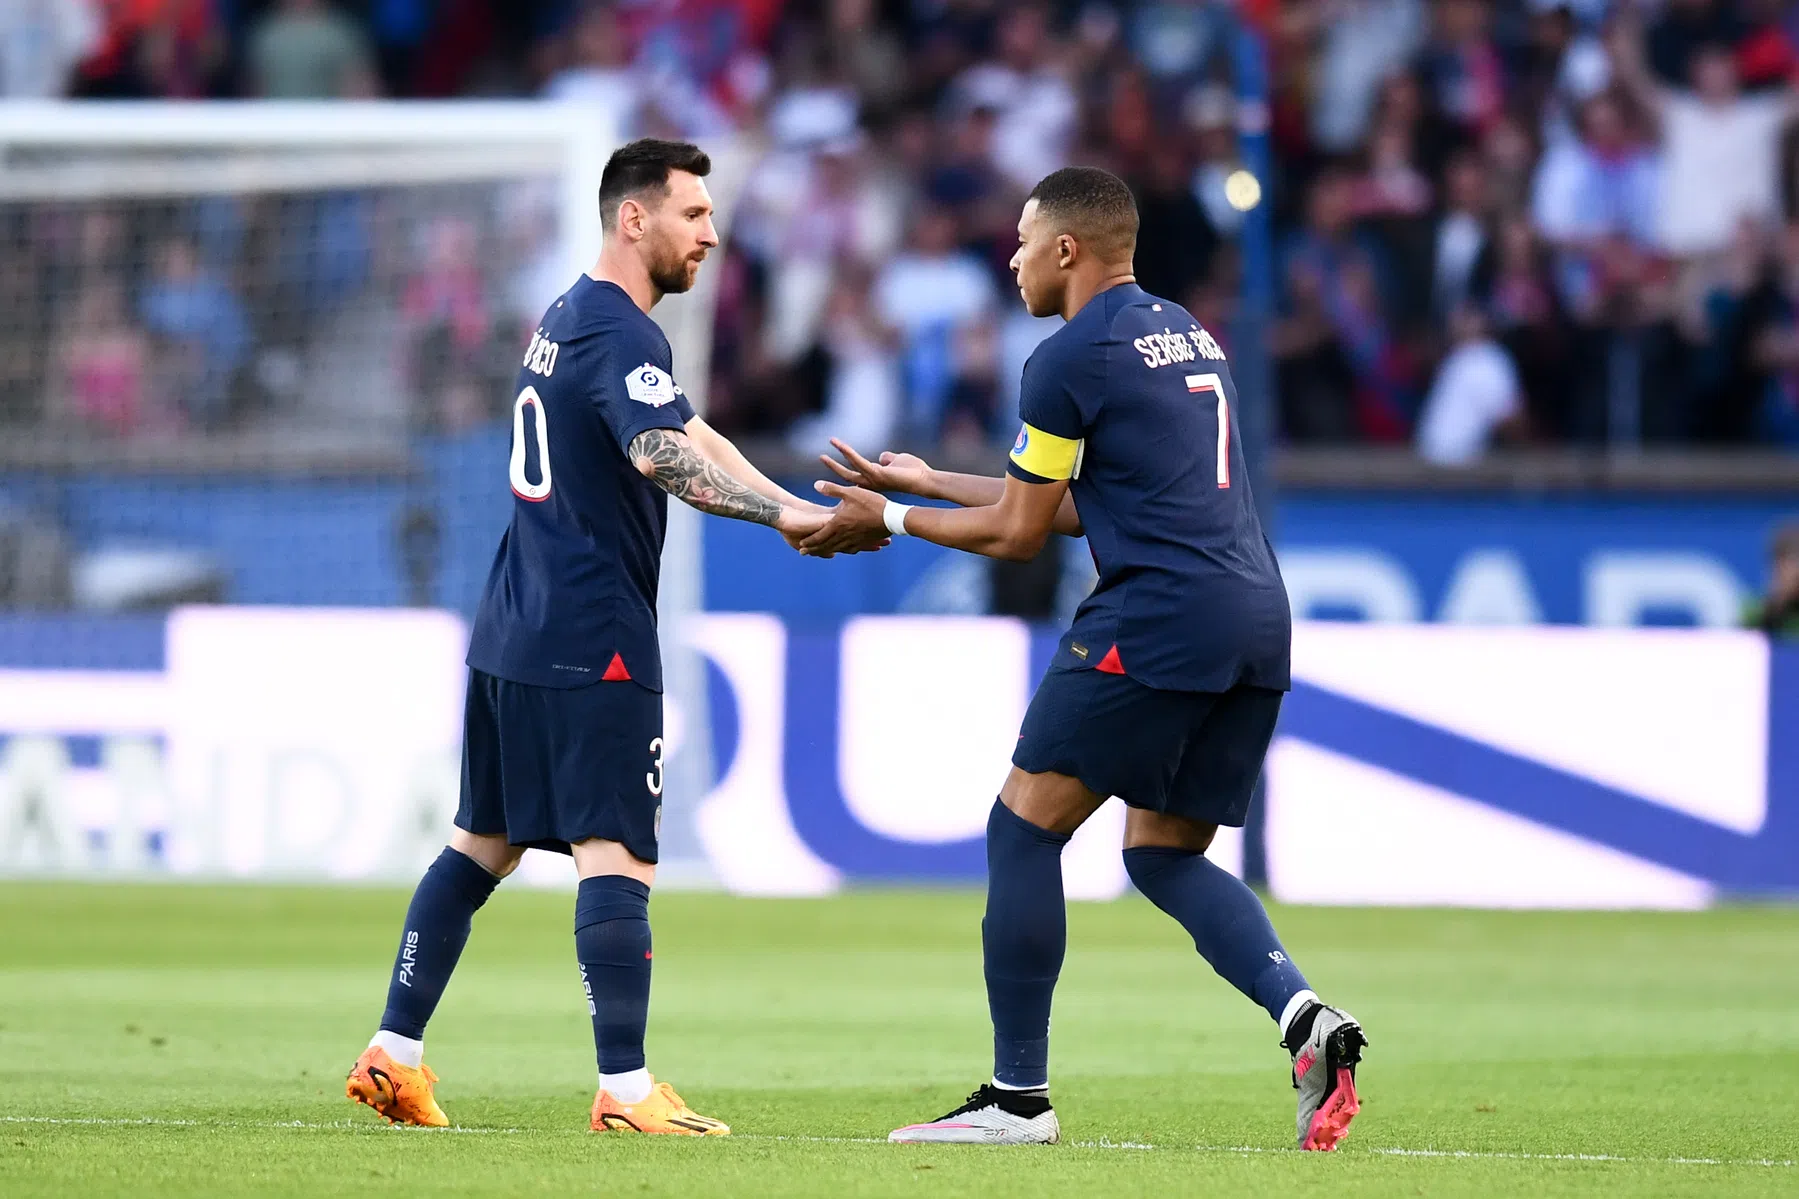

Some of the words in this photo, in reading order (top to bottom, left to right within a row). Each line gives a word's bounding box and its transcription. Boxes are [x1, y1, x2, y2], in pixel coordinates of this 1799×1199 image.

[1185, 373, 1230, 489] 7
[646, 736, 664, 797] 3
[399, 930, 420, 987] PARIS
